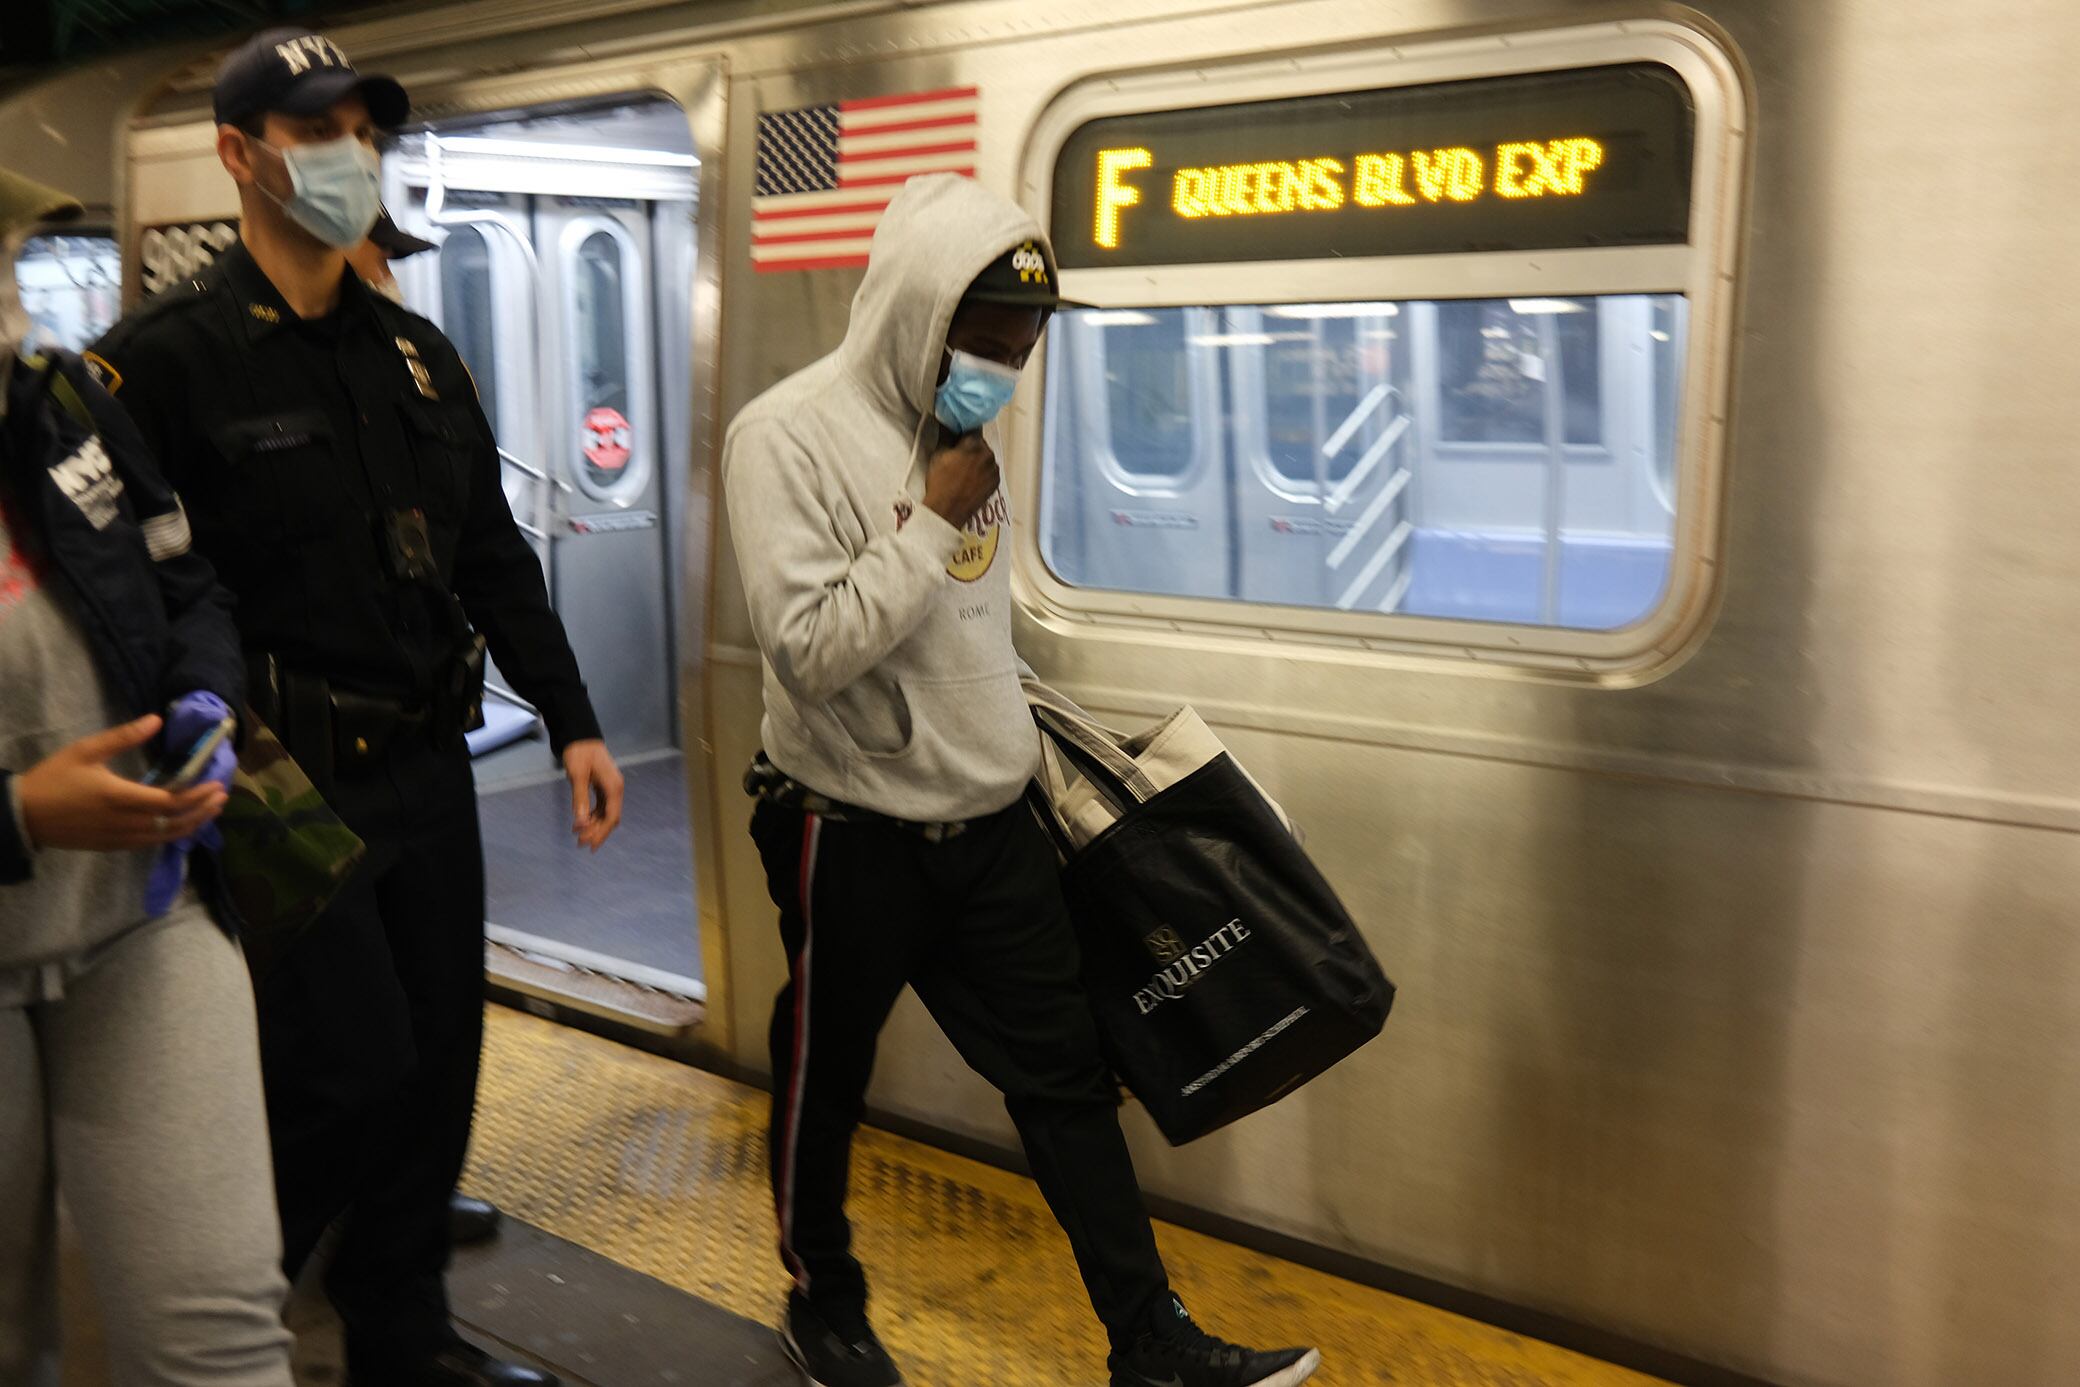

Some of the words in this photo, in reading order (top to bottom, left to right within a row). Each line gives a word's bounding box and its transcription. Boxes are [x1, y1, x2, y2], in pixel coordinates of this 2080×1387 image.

[1095, 148, 1152, 247] F
[1173, 159, 1345, 218] QUEENS
[1354, 147, 1483, 207] BLVD
[1495, 138, 1602, 198] EXP
[952, 545, 984, 566] CAFE
[958, 603, 991, 622] ROME
[1132, 917, 1252, 1015] EXQUISITE
